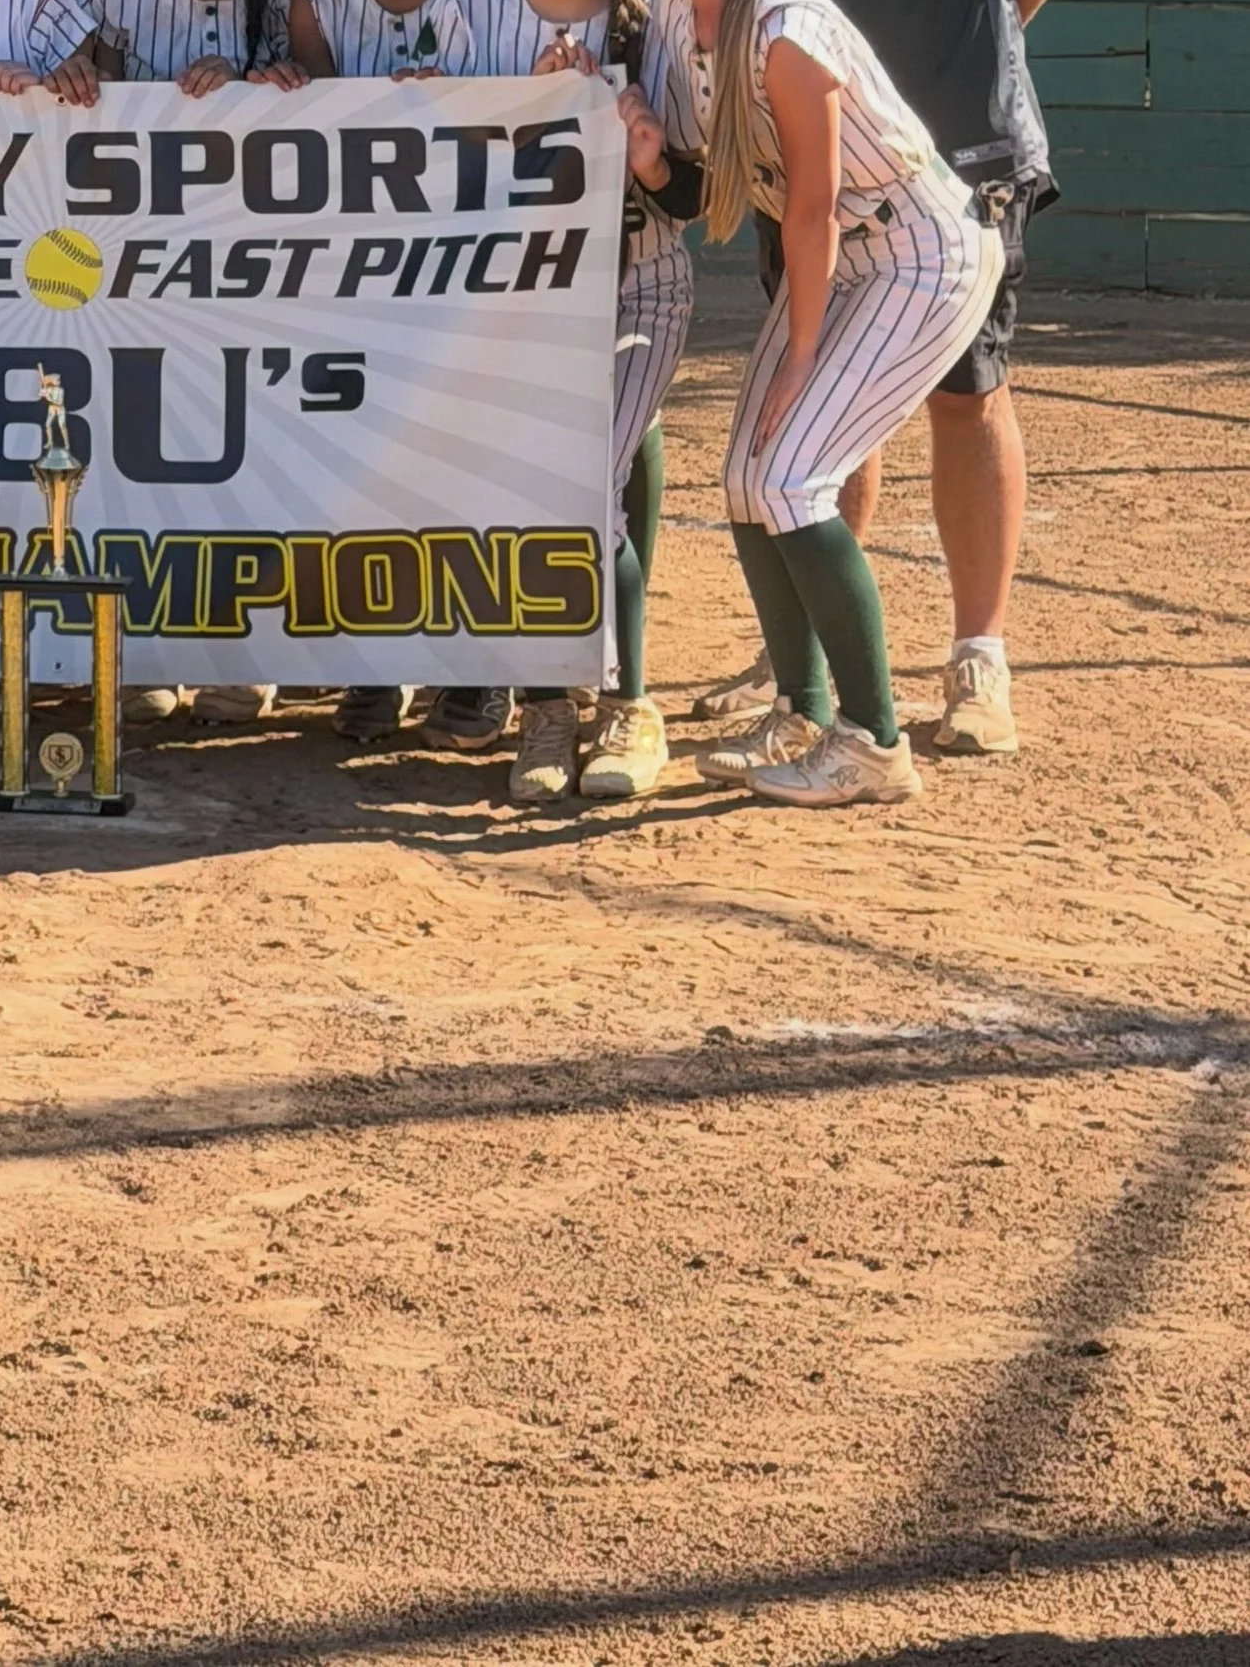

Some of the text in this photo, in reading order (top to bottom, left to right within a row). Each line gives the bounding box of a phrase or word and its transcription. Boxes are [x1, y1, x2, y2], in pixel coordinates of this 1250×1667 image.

[65, 117, 587, 217] SPORTS
[108, 227, 590, 299] FAST PITCH
